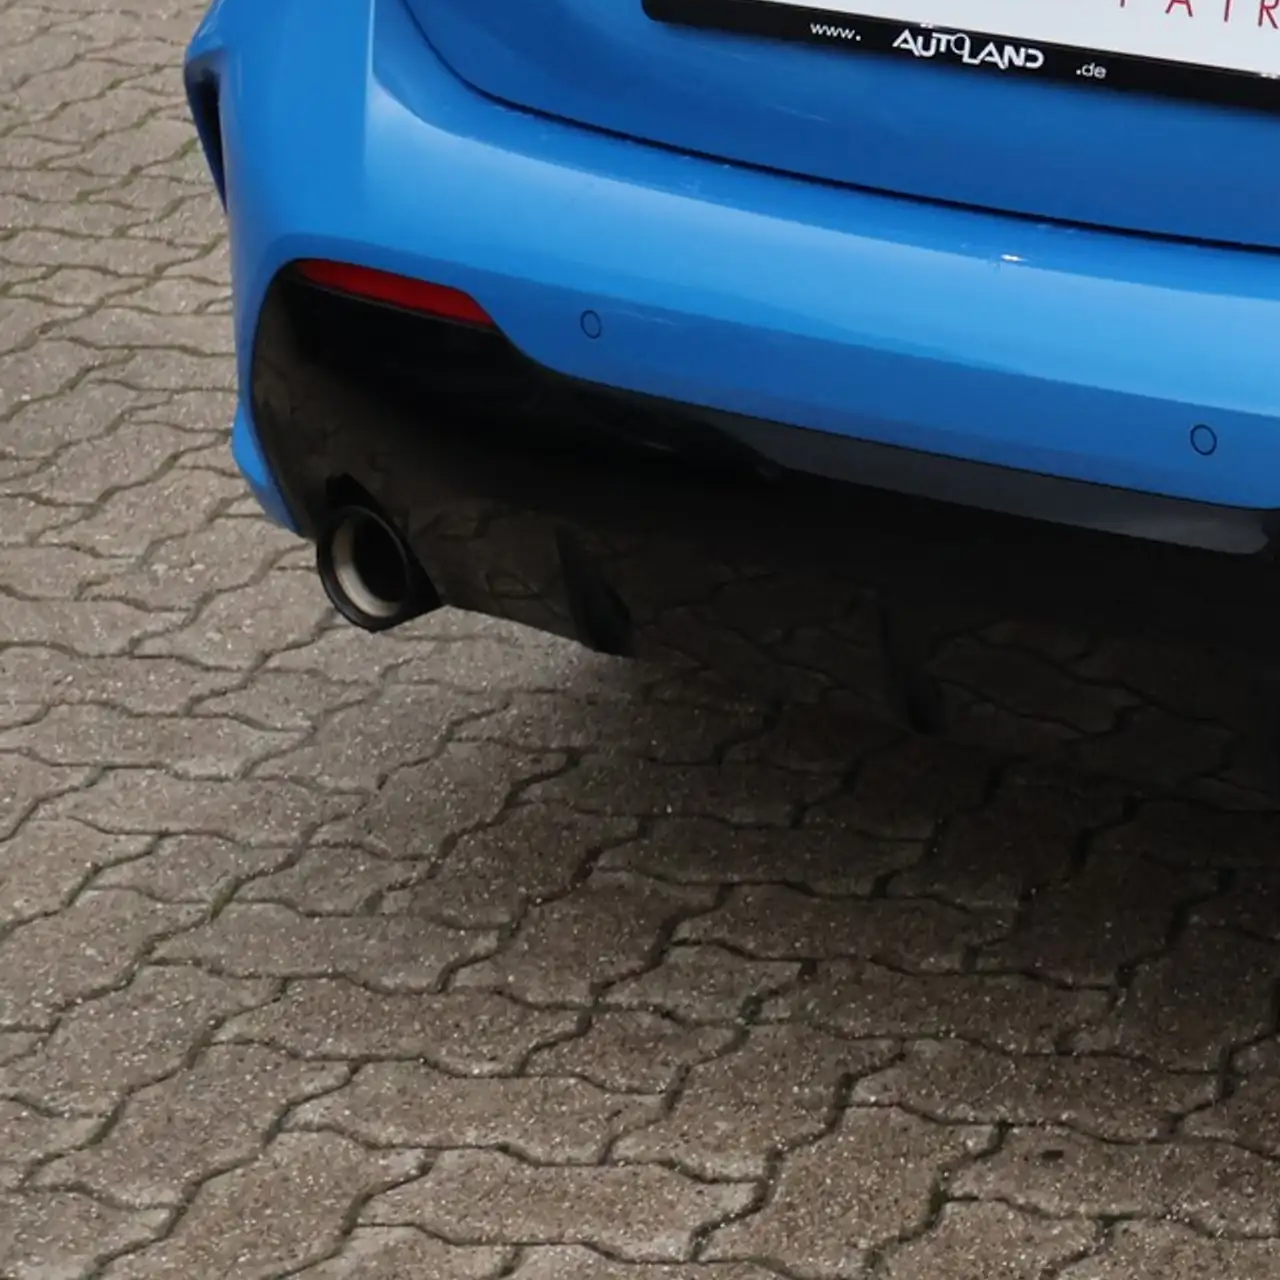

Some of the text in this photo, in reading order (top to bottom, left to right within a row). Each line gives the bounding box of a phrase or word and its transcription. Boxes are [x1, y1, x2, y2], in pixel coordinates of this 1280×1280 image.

[809, 22, 1107, 80] www. AUTOLAND .de
